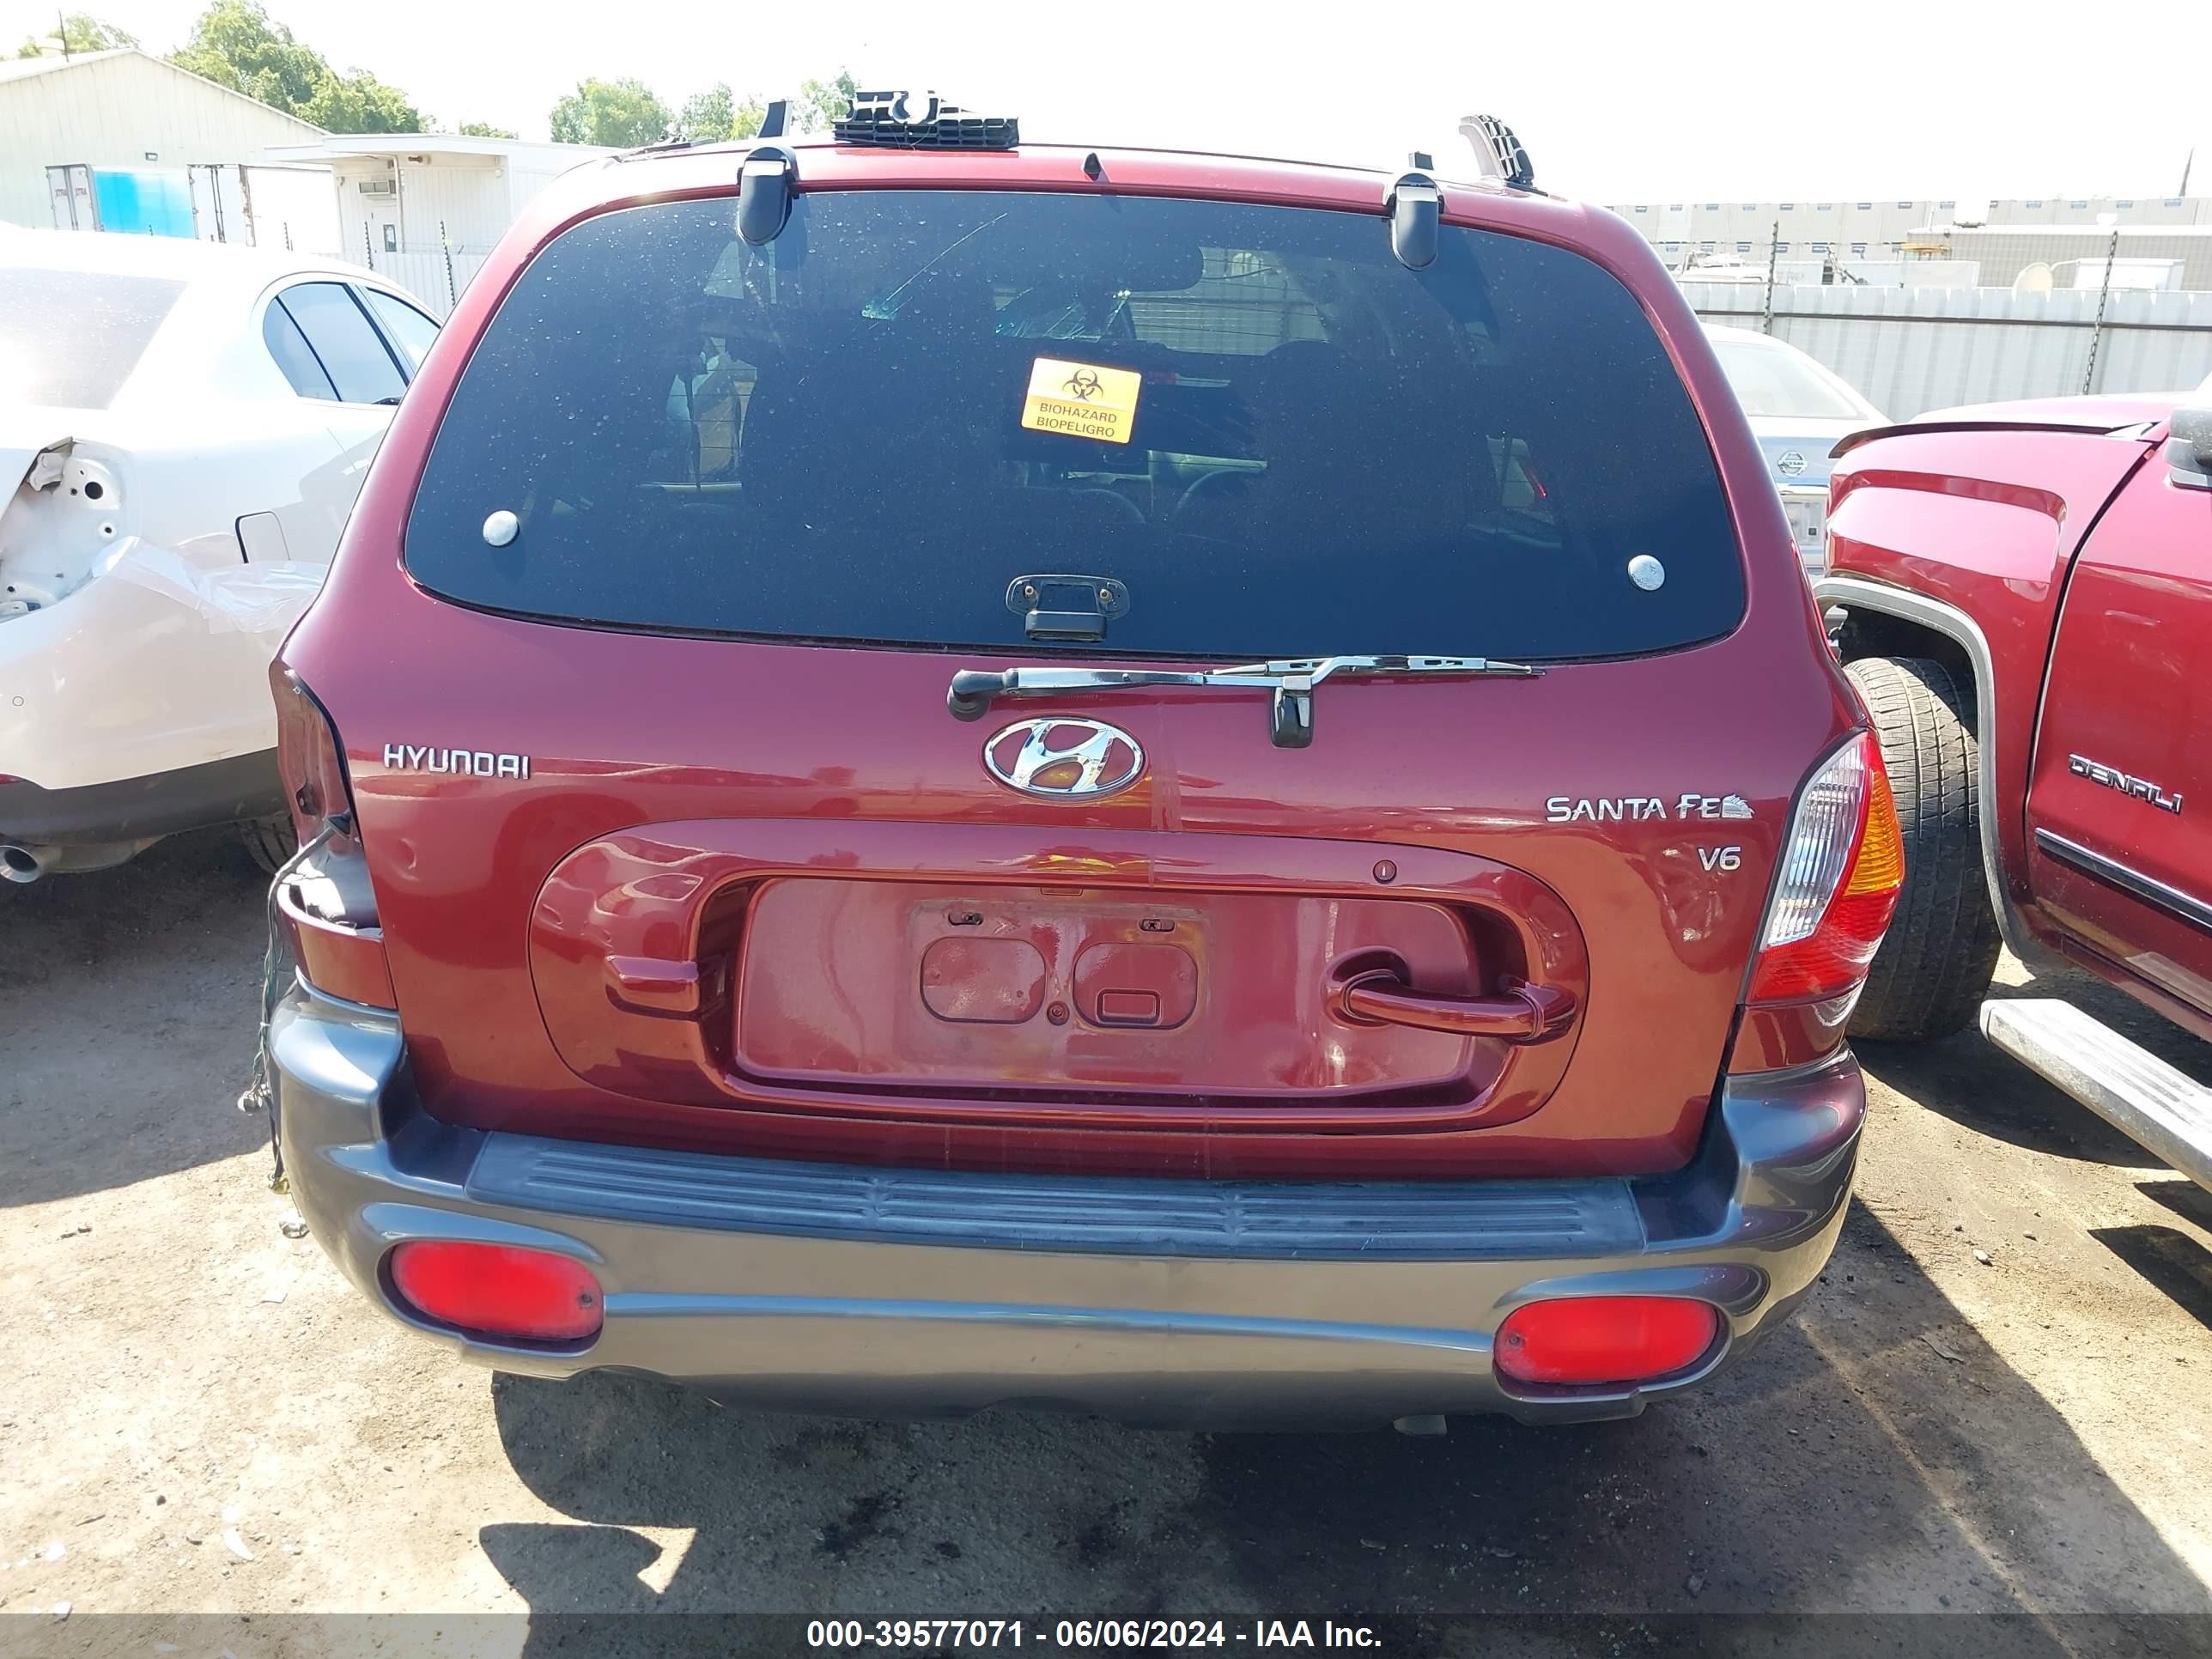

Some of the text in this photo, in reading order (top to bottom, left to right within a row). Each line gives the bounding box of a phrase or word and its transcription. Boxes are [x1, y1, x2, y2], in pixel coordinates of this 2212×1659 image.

[1040, 403, 1117, 423] BIOHAZARD
[1036, 416, 1115, 437] BIOPELIGRO
[384, 744, 530, 780] HYUNDAI
[2069, 753, 2183, 814] DENALI
[1547, 797, 1668, 823] SANTA
[1698, 846, 1741, 871] V6
